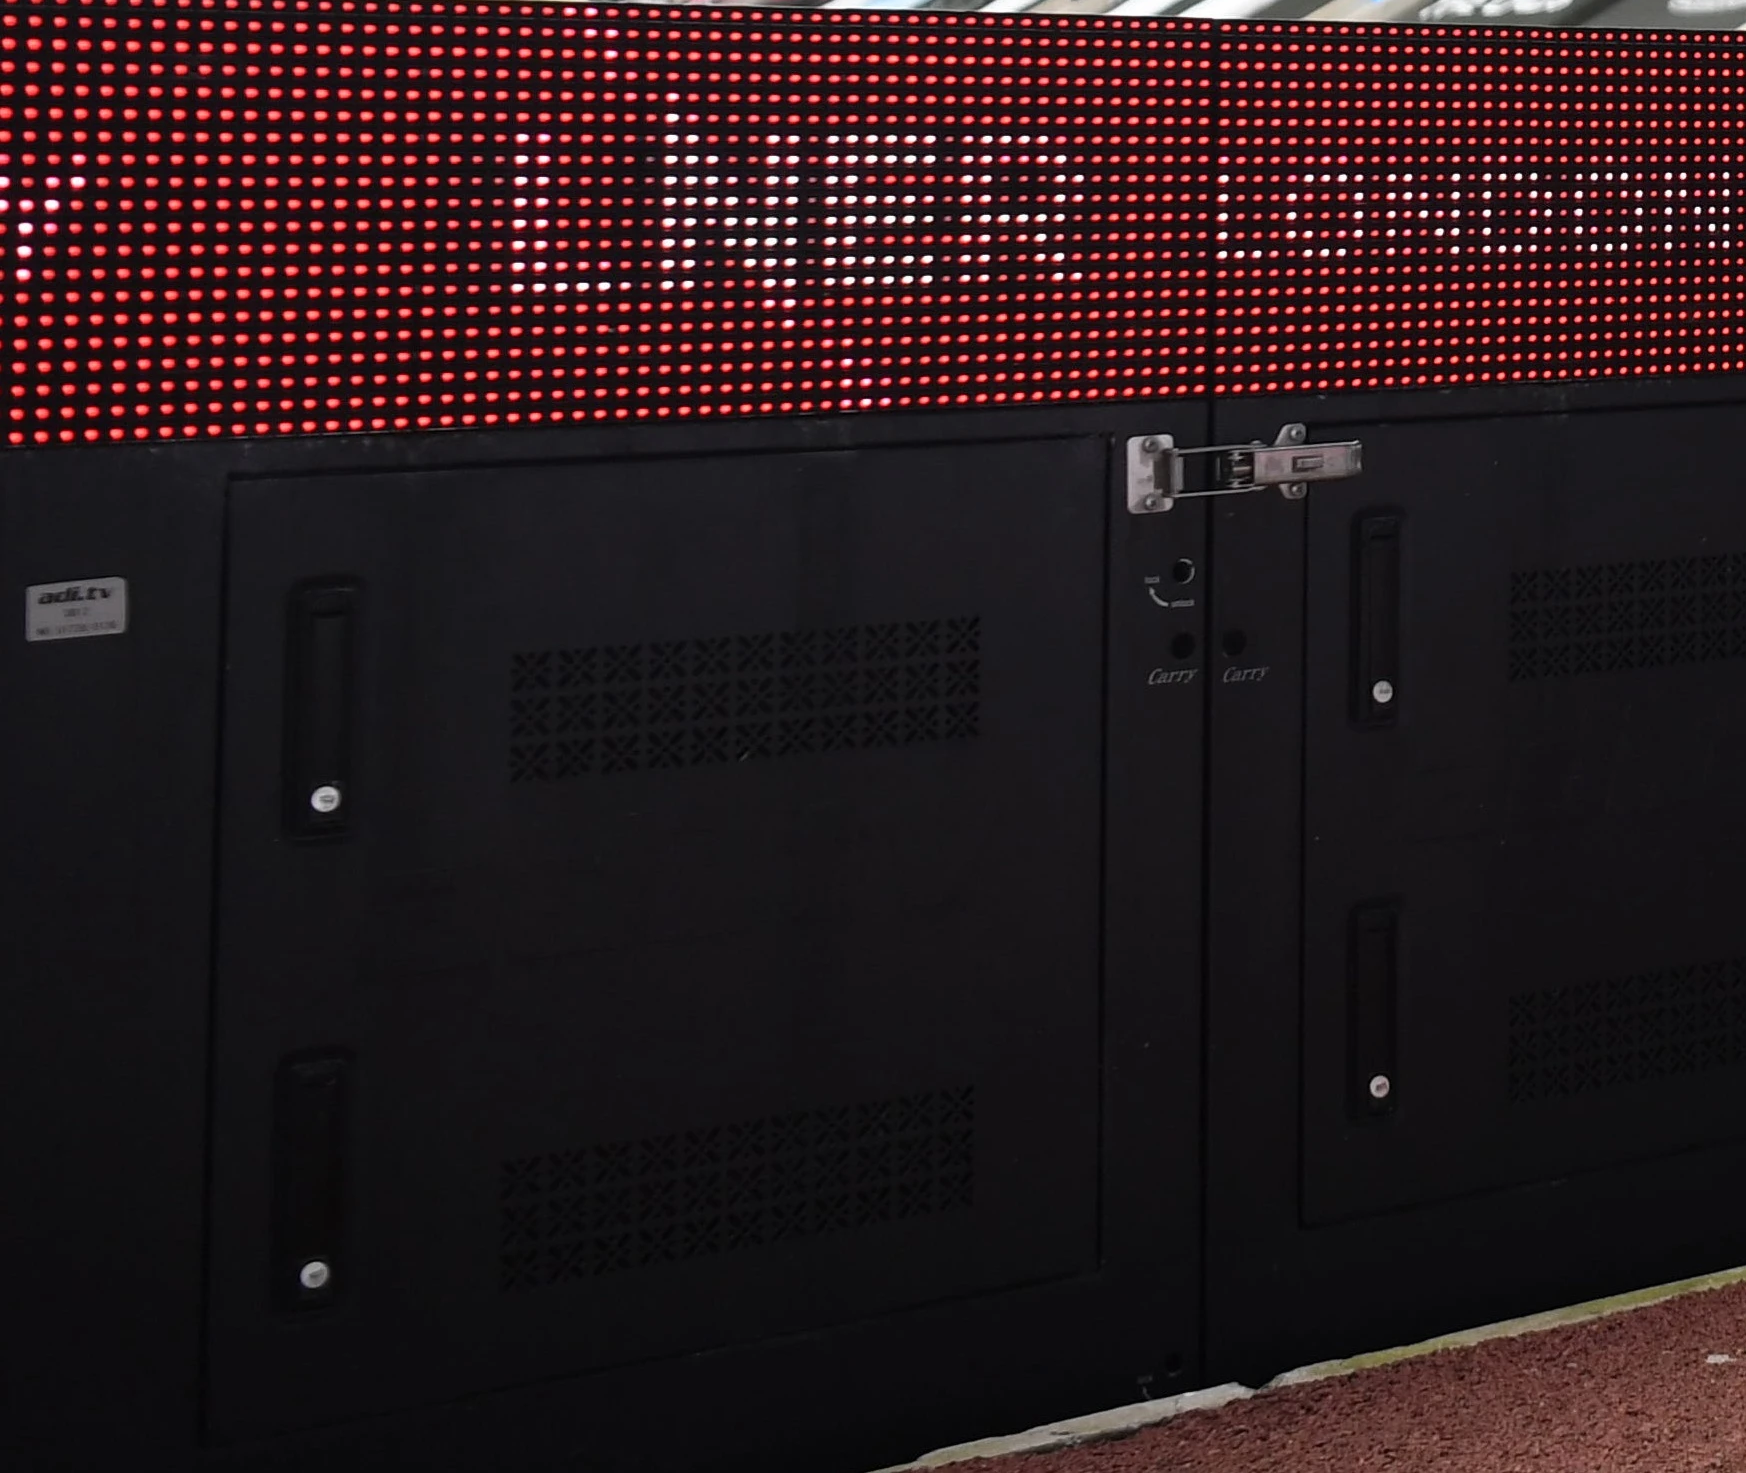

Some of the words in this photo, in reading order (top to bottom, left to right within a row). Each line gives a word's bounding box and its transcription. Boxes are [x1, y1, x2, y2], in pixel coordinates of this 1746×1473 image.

[510, 124, 1085, 298] LNER
[1213, 158, 1735, 263] LONDON
[37, 586, 112, 605] adi.tv
[1148, 667, 1199, 685] Carry
[1222, 666, 1271, 684] Carry
